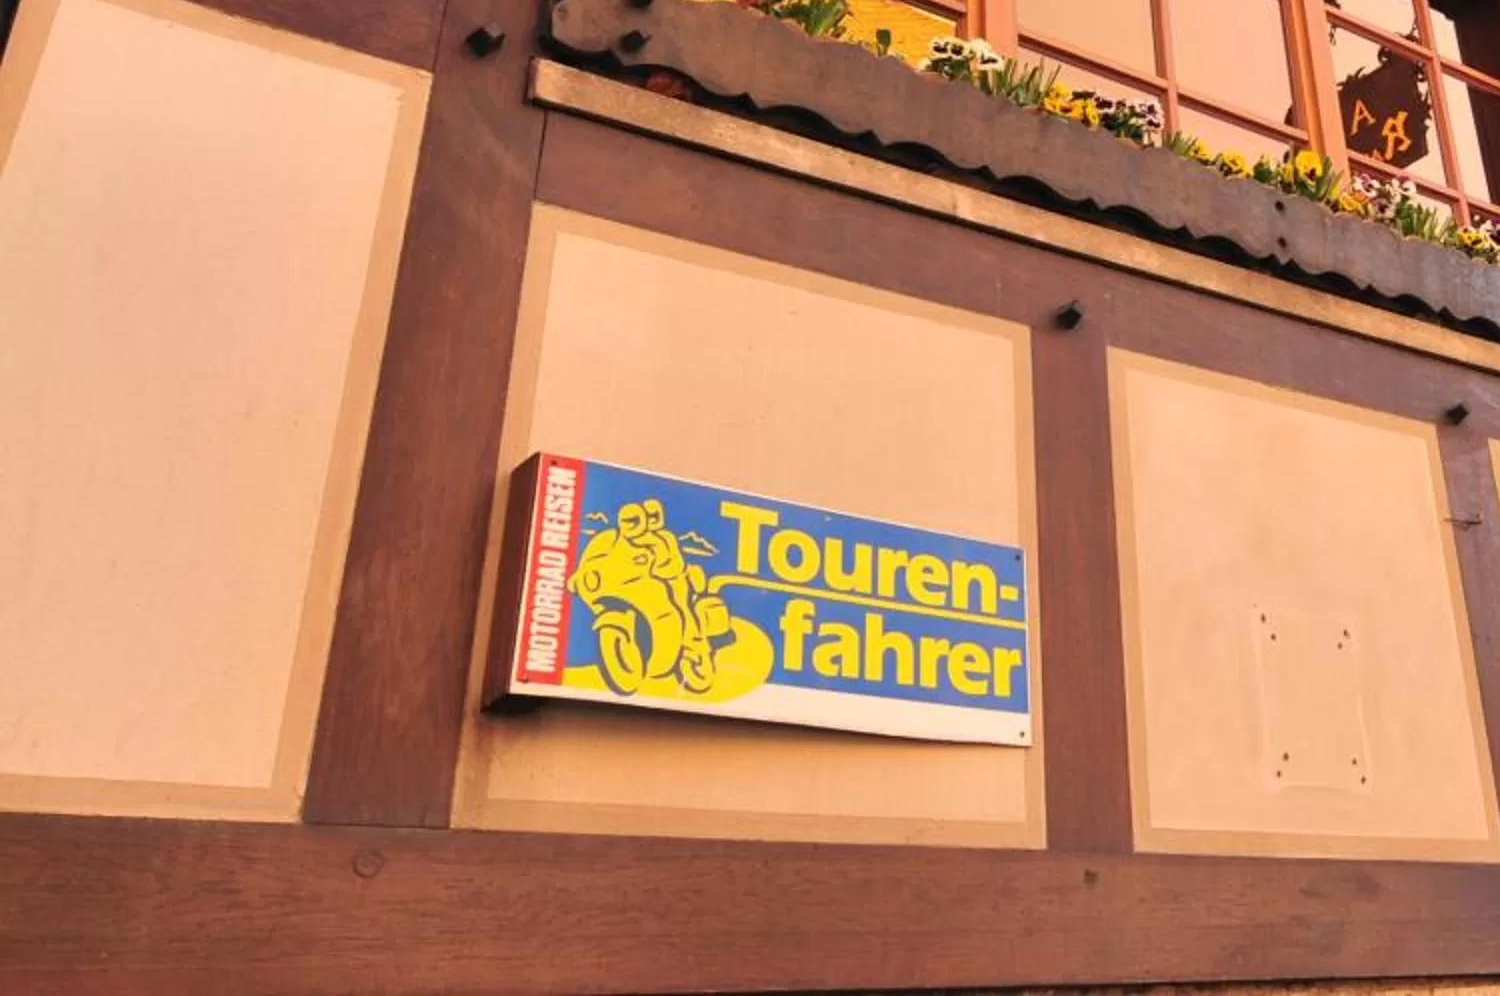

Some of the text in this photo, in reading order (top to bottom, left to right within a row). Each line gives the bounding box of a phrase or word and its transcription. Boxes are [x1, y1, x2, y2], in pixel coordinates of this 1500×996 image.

[525, 466, 577, 673] MOTORRAD REISEN
[719, 500, 1019, 614] Touren-
[779, 599, 1022, 697] fahrer
